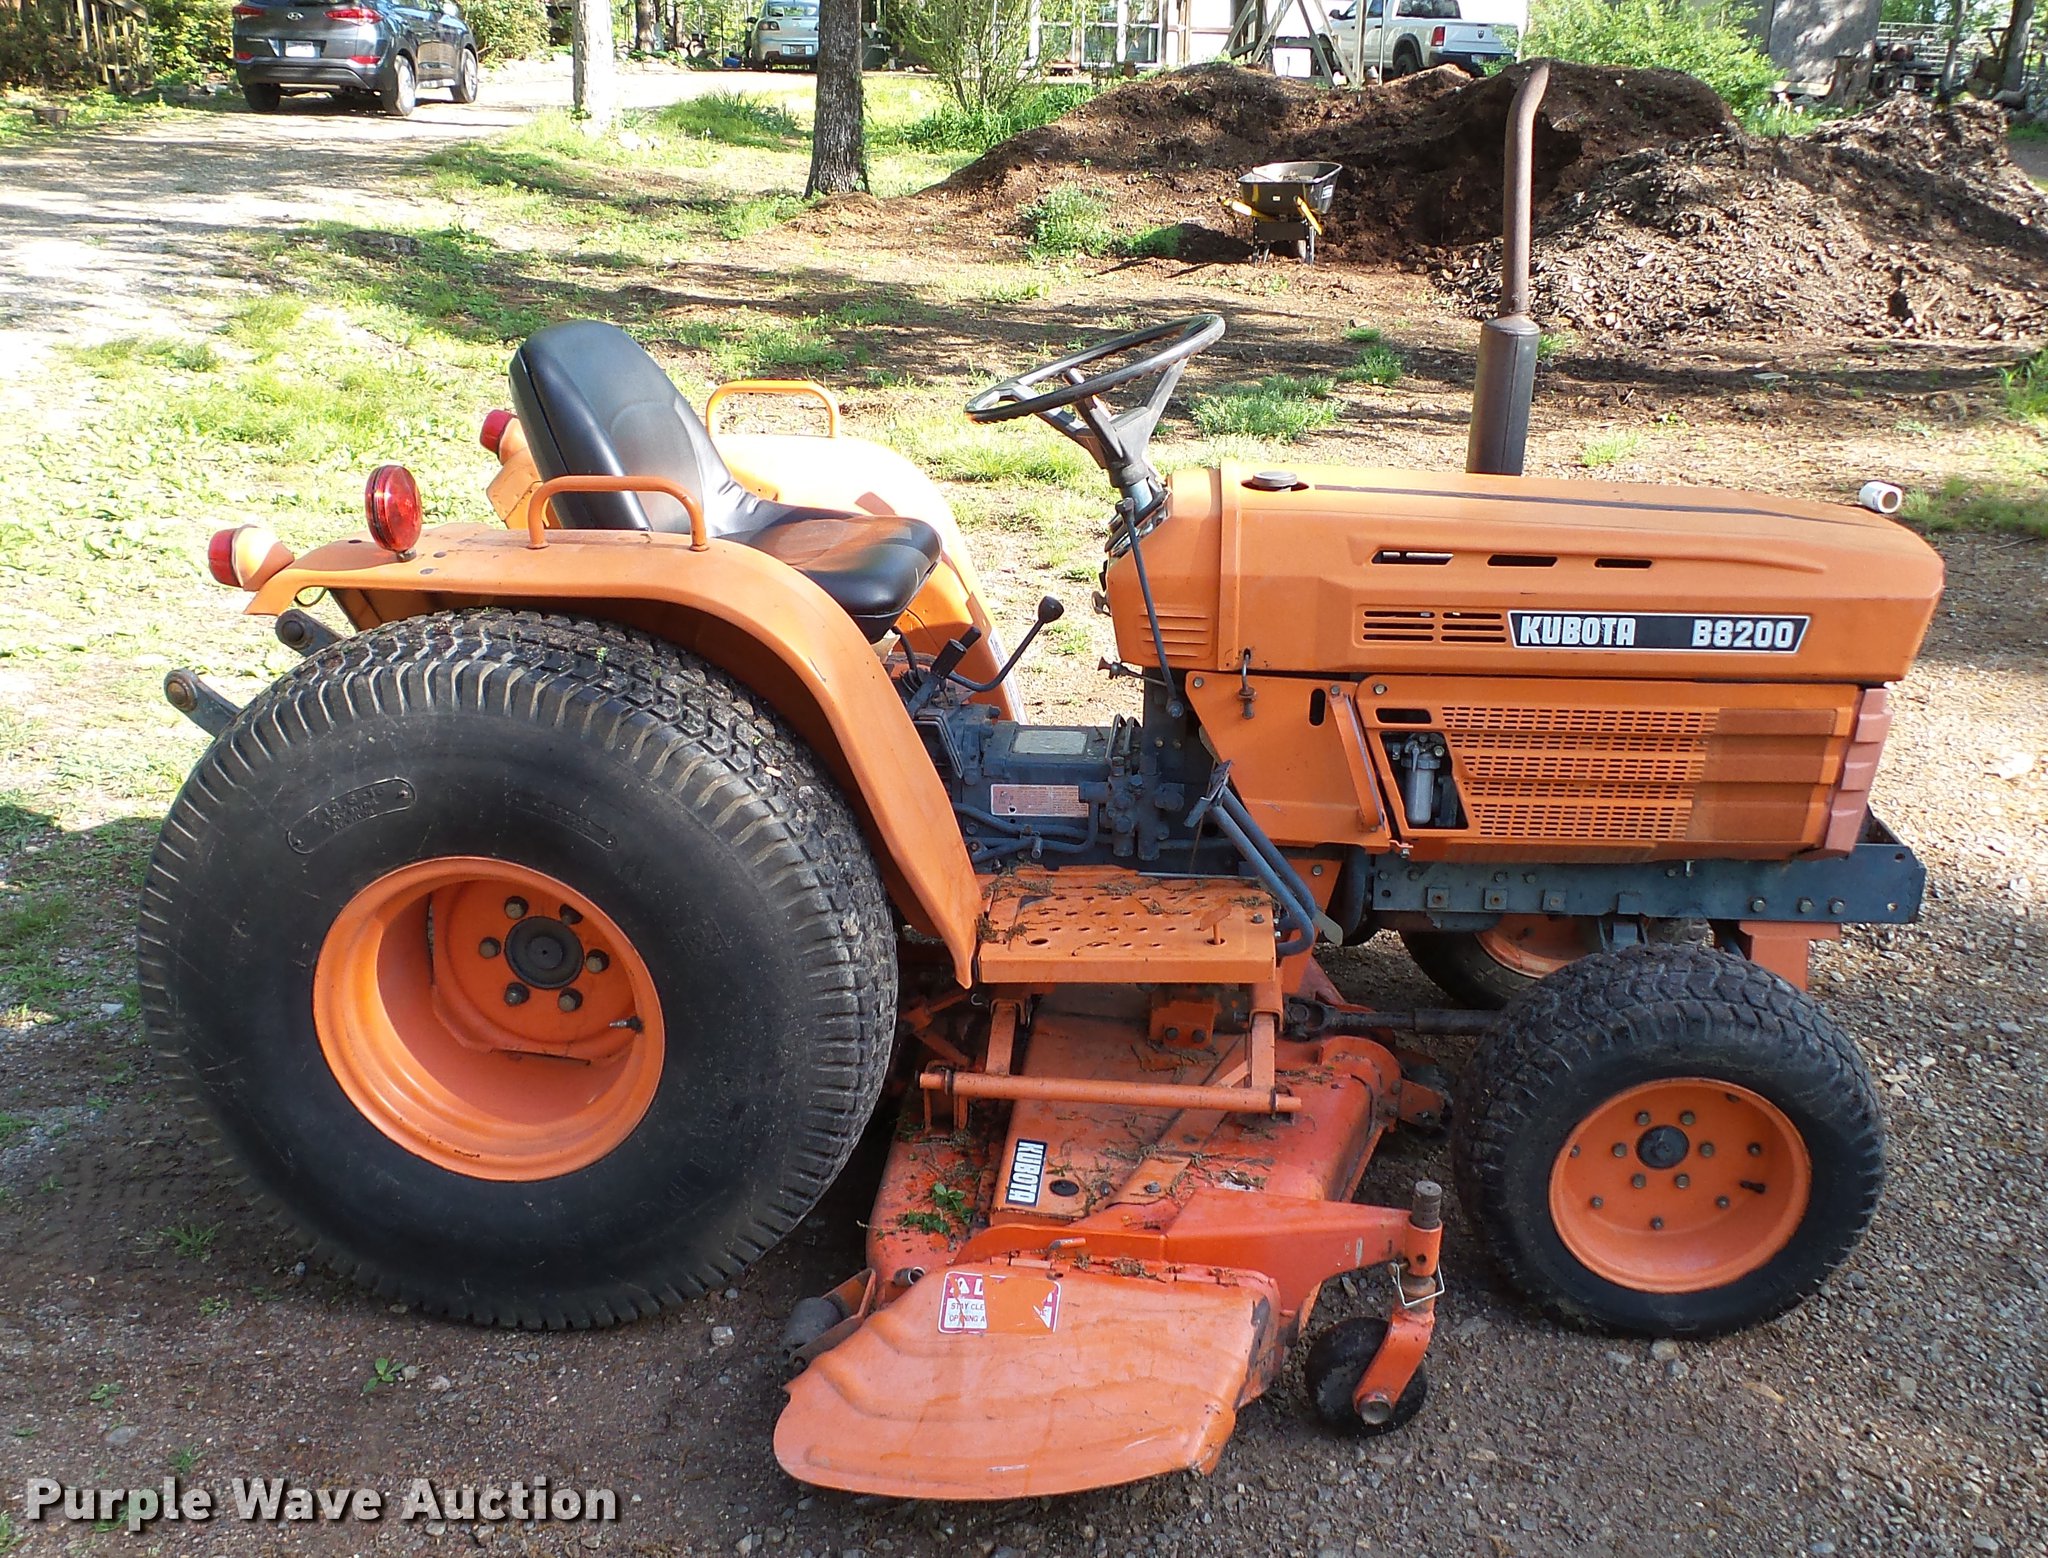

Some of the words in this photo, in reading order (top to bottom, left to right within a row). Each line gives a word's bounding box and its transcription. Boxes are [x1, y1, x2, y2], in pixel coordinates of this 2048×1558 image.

[1519, 616, 1636, 646] KUBOTA
[1691, 619, 1796, 648] B8200
[1008, 1142, 1045, 1203] KUBOTA
[949, 1314, 978, 1322] OPNING
